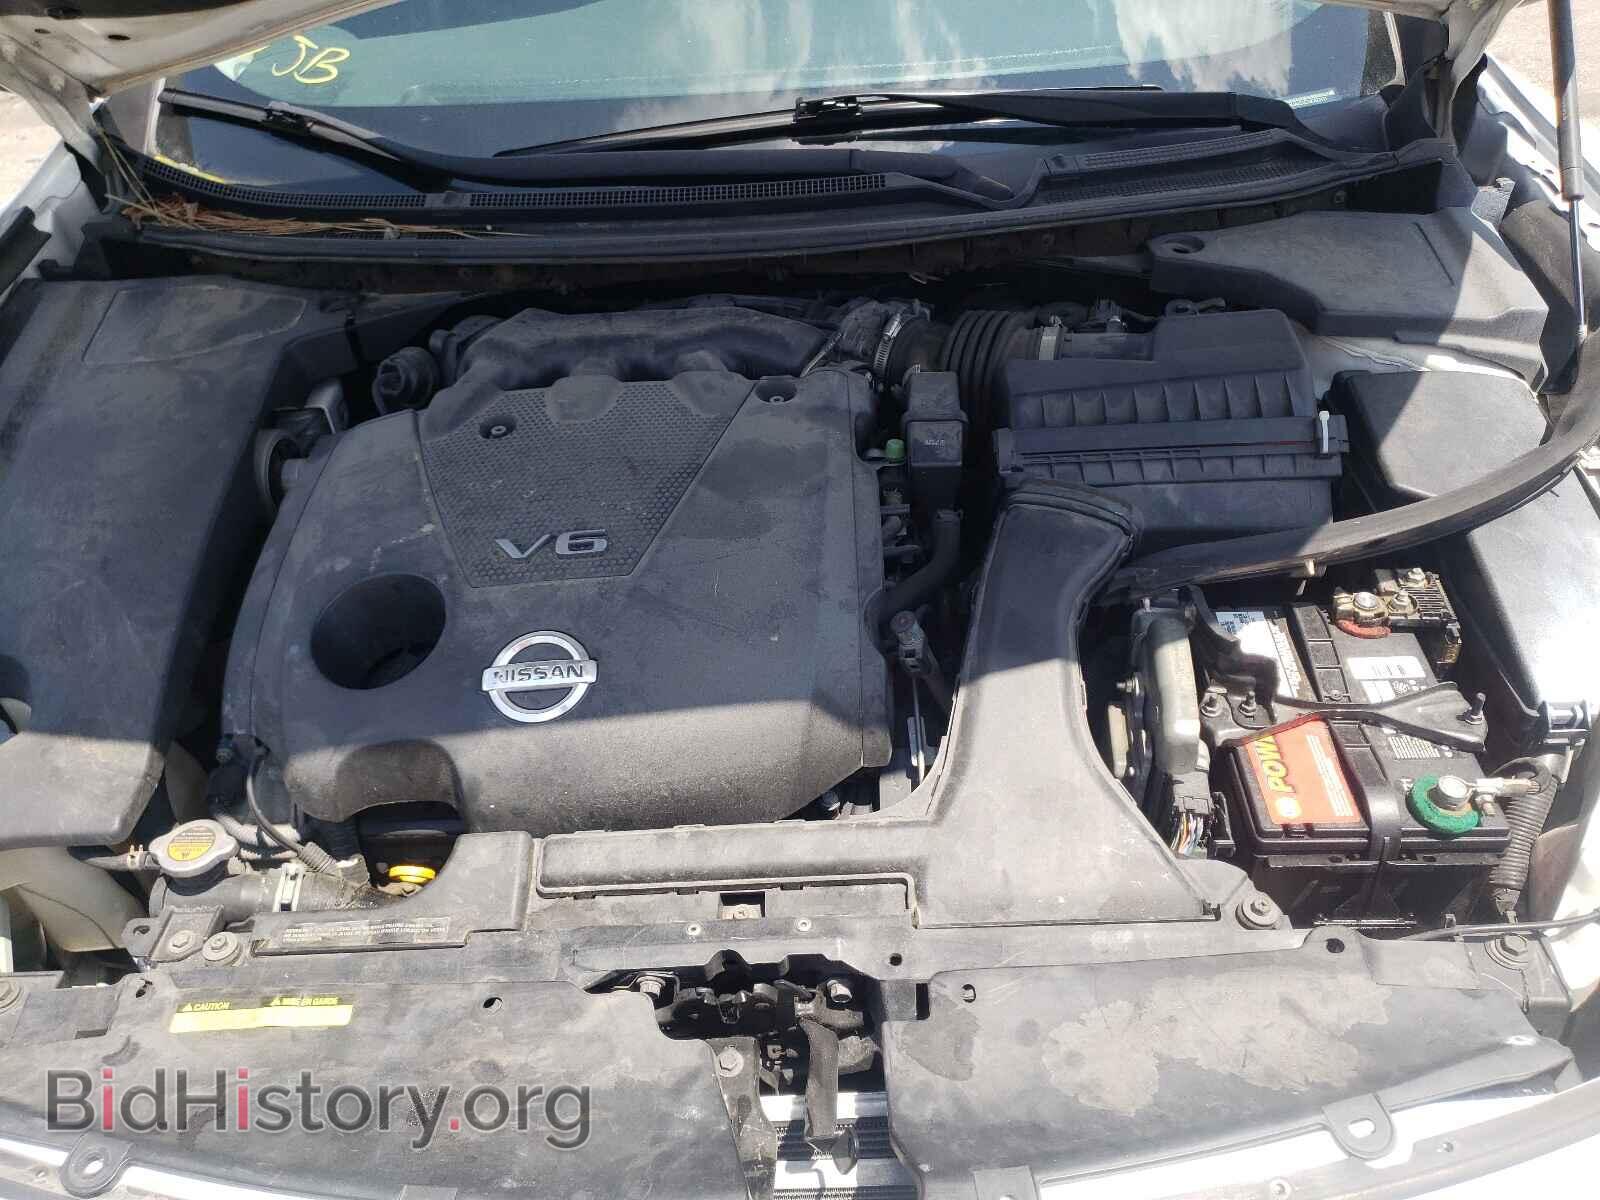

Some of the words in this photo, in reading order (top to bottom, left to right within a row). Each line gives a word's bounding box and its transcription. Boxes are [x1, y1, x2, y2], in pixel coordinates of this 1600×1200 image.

[496, 529, 608, 559] V6
[493, 664, 585, 683] NISSAN
[1254, 734, 1296, 793] POW
